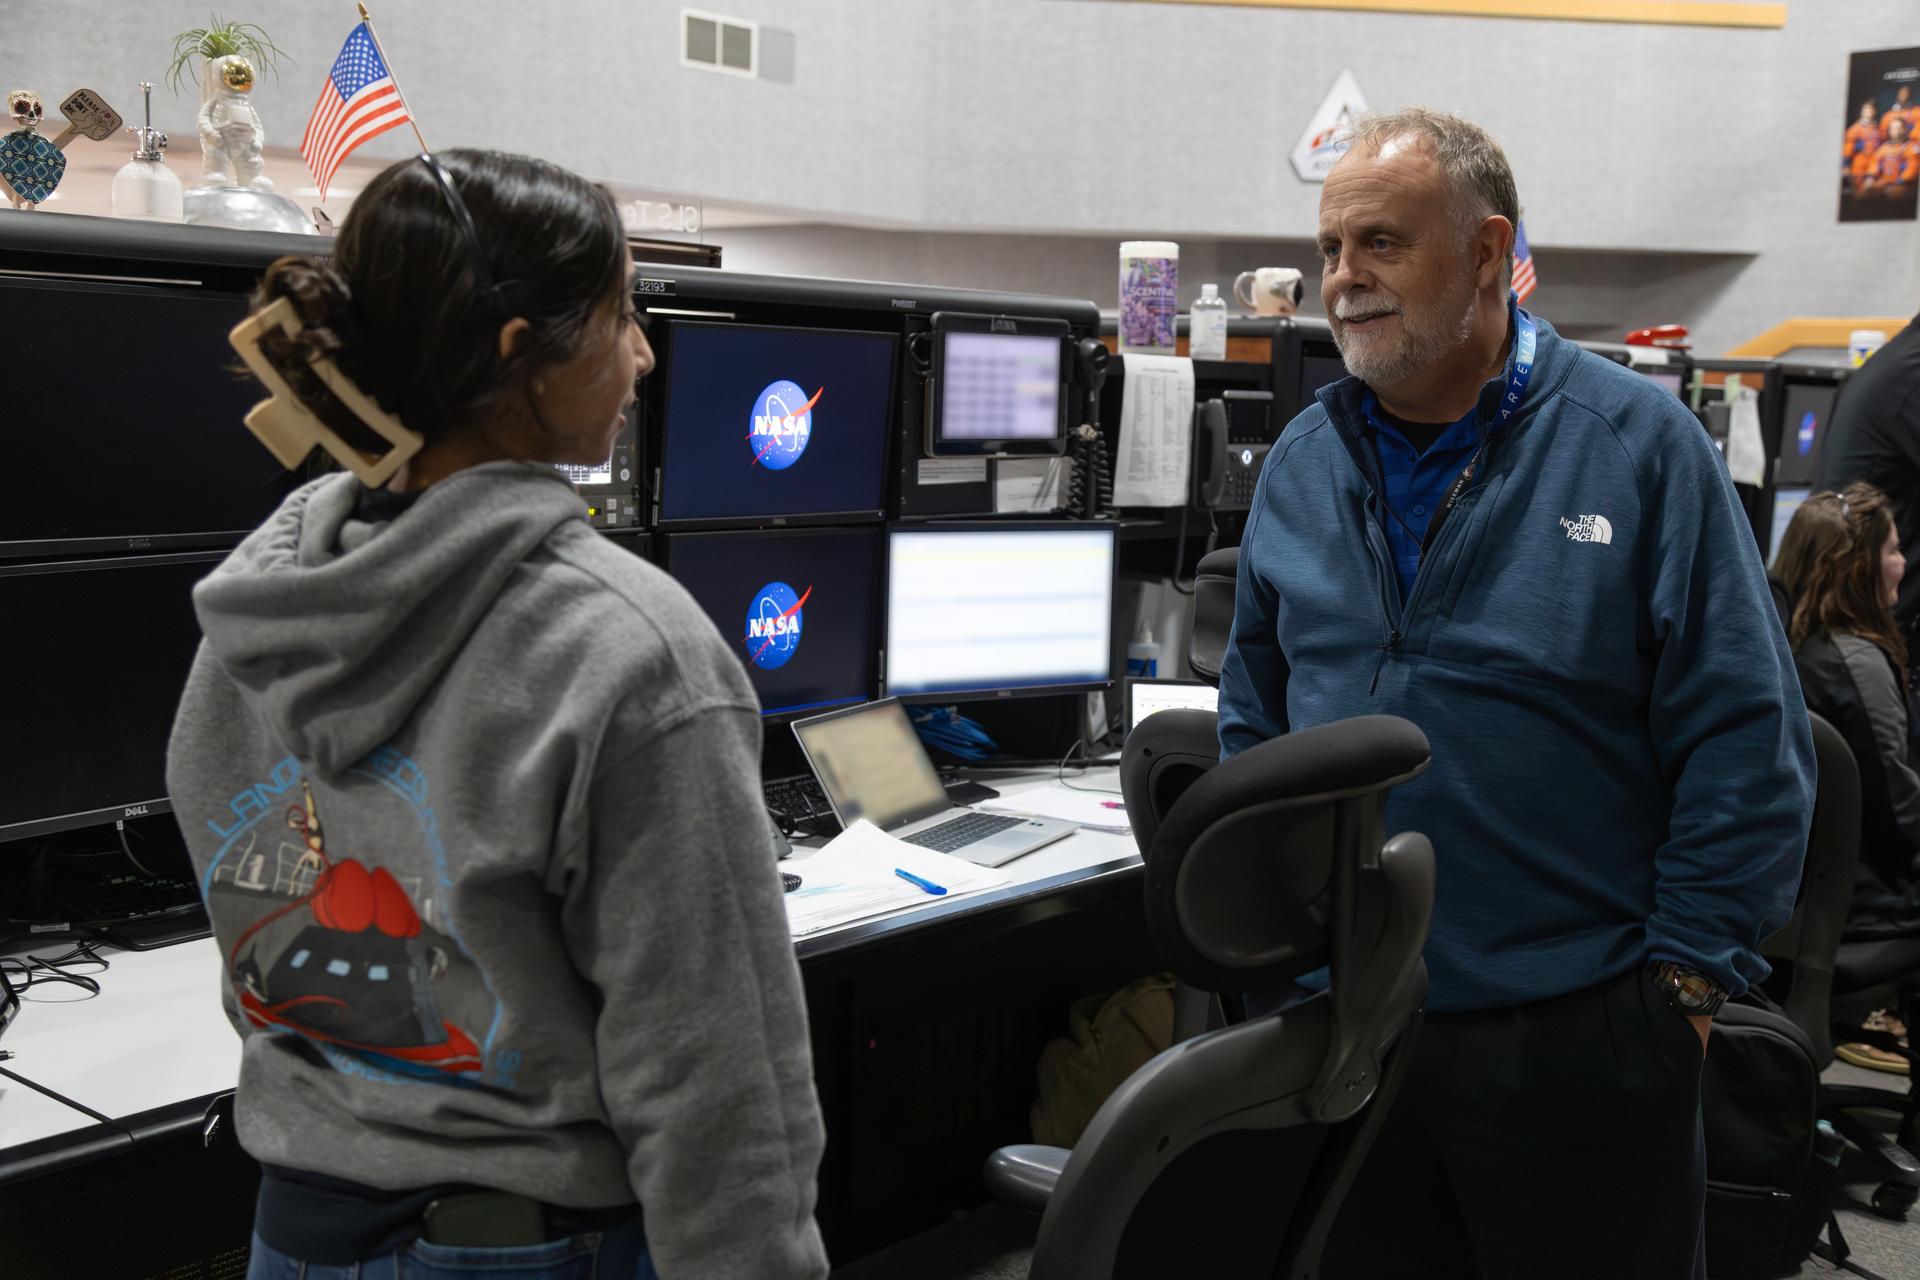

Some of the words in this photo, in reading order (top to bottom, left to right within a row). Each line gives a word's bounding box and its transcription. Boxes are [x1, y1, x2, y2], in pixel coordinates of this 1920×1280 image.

[78, 92, 100, 113] PLEASE
[1501, 329, 1534, 420] ARTEMIS
[754, 416, 809, 436] NASA
[1559, 516, 1594, 534] NORTH
[1579, 514, 1596, 524] THE
[1566, 529, 1591, 542] FACE
[749, 615, 800, 638] NASA
